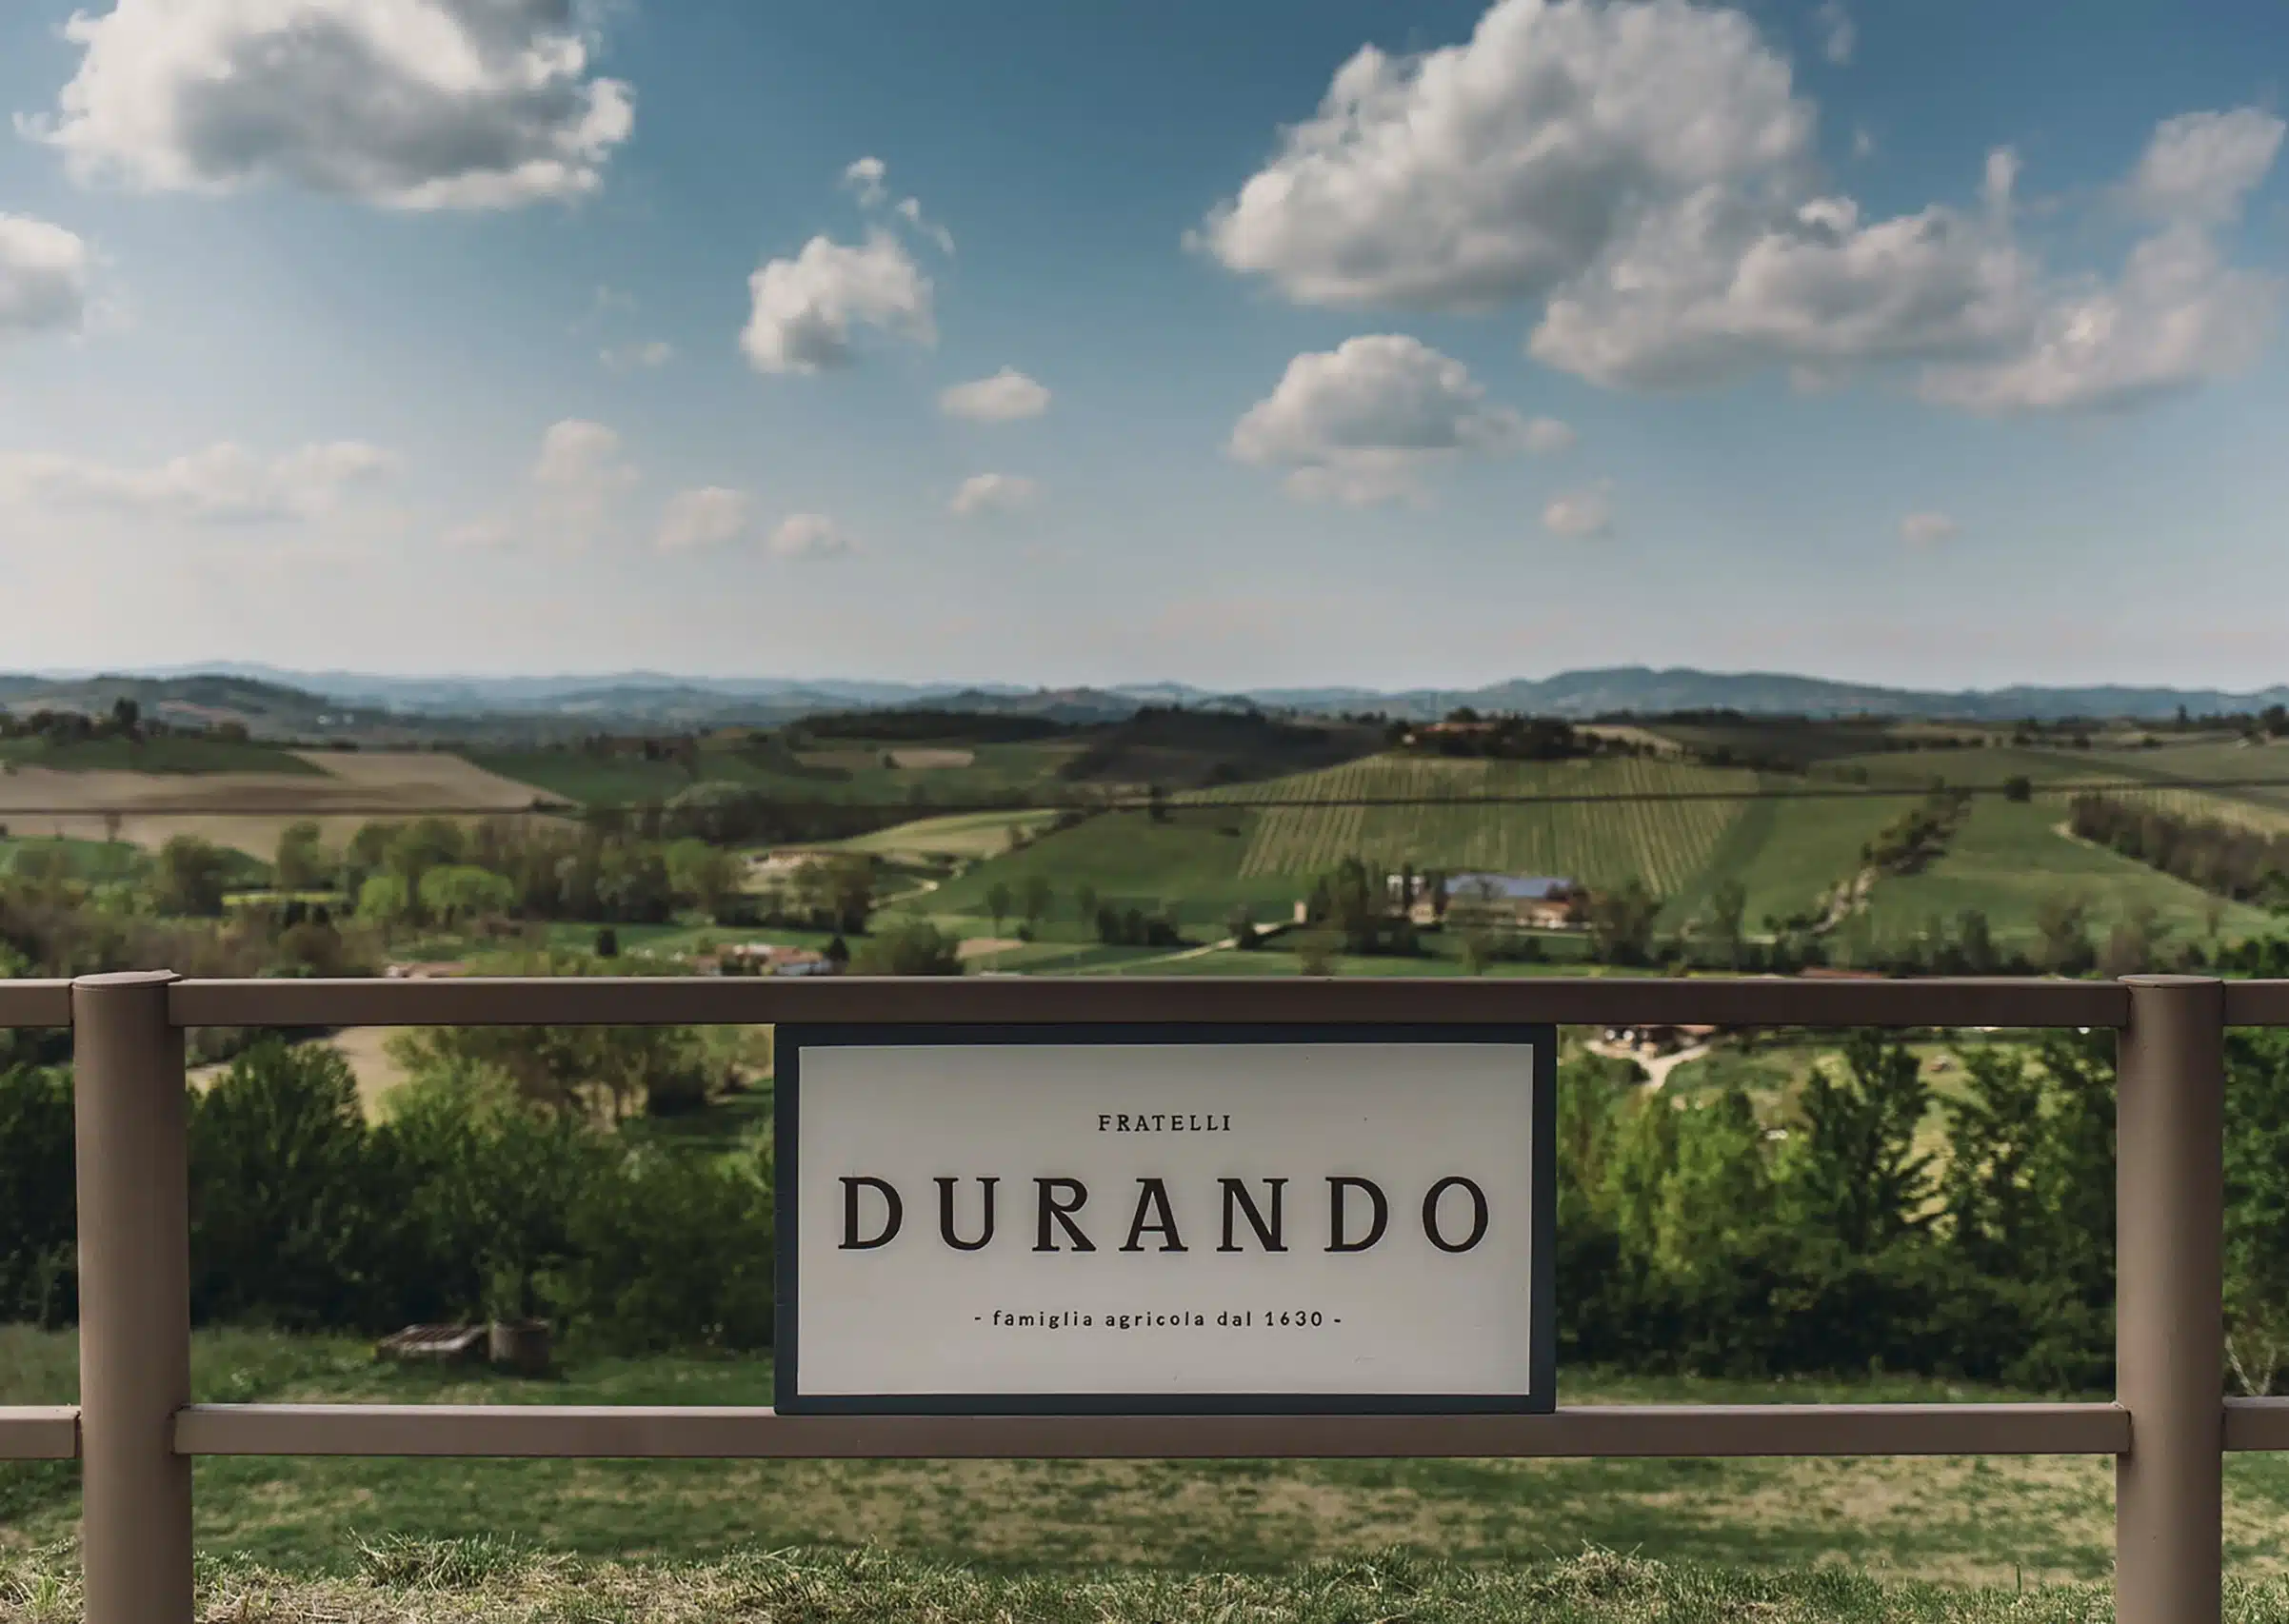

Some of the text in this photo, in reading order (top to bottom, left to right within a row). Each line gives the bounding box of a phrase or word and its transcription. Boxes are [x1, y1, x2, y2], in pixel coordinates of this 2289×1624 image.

[1097, 1114, 1233, 1133] FRATELLI
[837, 1176, 1490, 1254] DURANDO
[992, 1309, 1093, 1331] famiglia
[1104, 1310, 1205, 1331] agricola
[1215, 1309, 1253, 1327] dal
[1264, 1310, 1324, 1327] 1630
